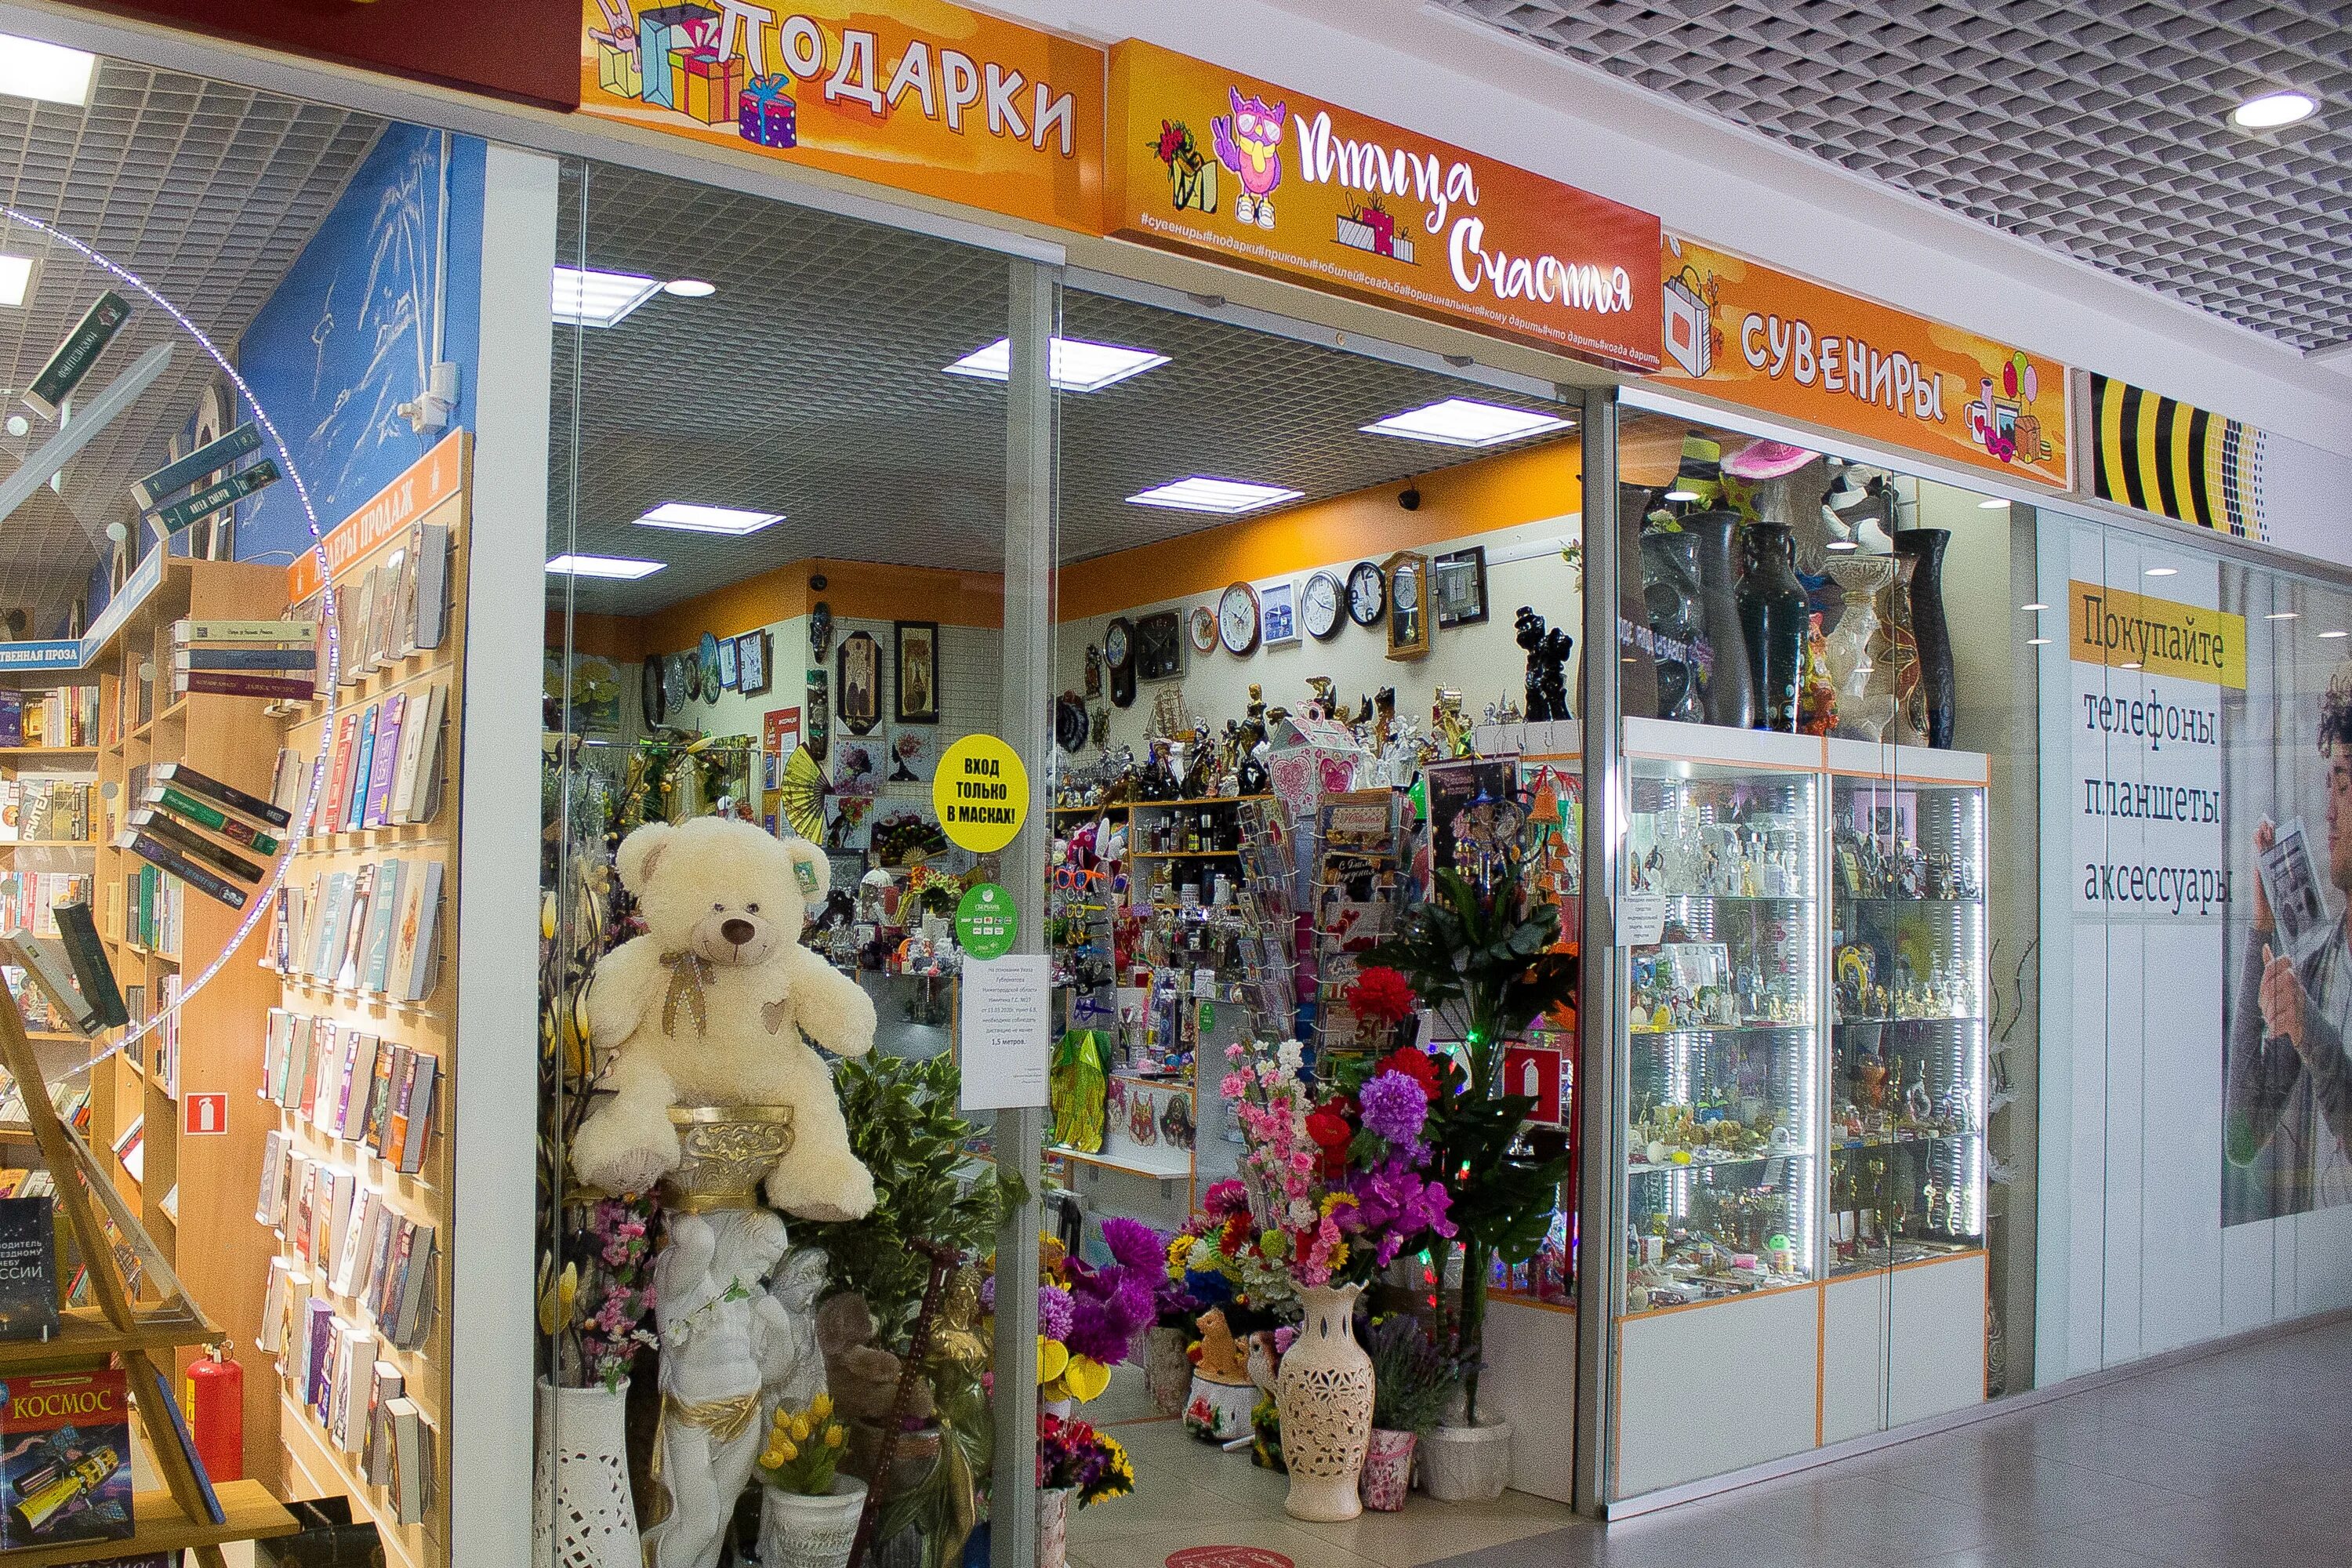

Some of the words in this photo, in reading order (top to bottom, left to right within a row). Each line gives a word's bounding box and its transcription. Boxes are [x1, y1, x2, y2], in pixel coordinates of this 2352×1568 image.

[713, 0, 1077, 158] ПОДАРКИ
[1292, 110, 1479, 234] Птица
[1448, 216, 1635, 314] Счастья
[1740, 312, 1947, 424] СУВЕНИРЫ
[360, 478, 414, 549] ПРОДАЖ
[45, 648, 78, 660] ПРОЗА
[2082, 593, 2225, 669] Покупайте
[2084, 690, 2216, 751] телефоны
[956, 781, 1007, 800] ТОЛЬКО
[964, 758, 1000, 779] ВХОД
[947, 806, 955, 822] В
[959, 806, 1015, 825] МАСКАХ!
[2084, 778, 2220, 824] планшеты
[2084, 862, 2233, 916] аксессуары
[0, 1240, 42, 1250] ОДИТЕЛЬ
[13, 1388, 112, 1419] КОСМОС
